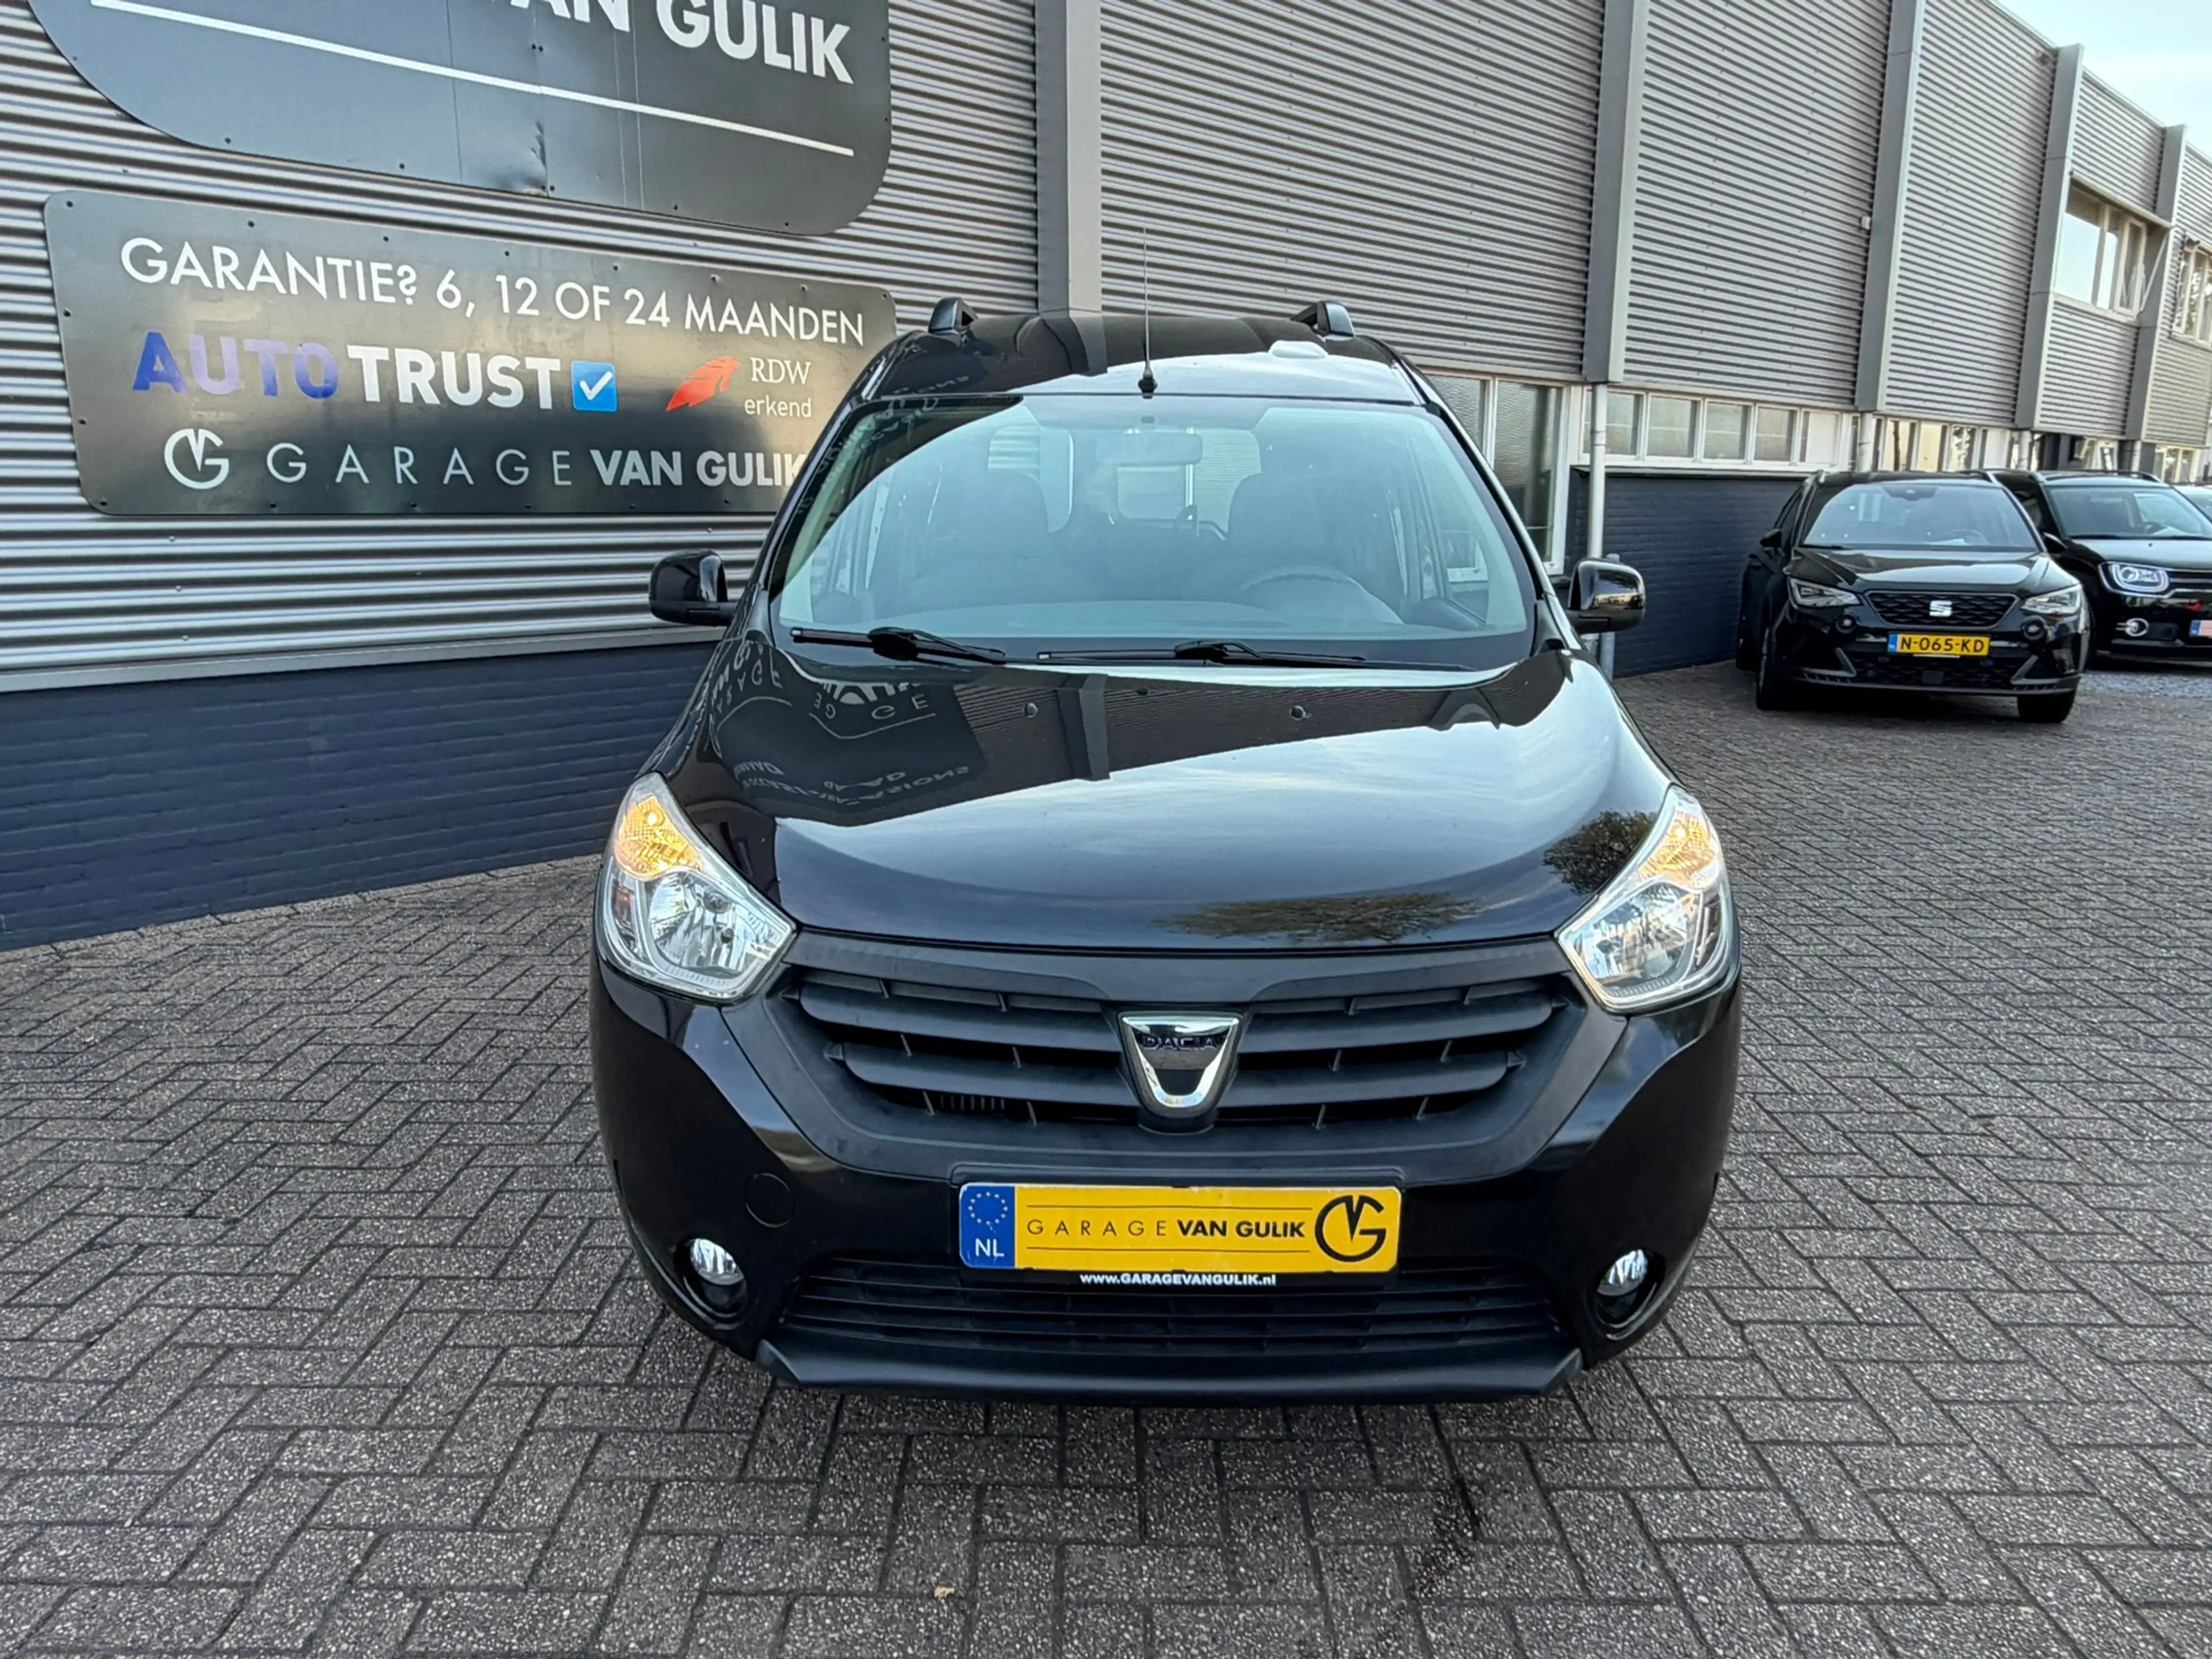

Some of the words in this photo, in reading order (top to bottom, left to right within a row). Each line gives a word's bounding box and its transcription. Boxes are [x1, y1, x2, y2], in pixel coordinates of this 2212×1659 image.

[656, 0, 854, 85] GULIK
[121, 237, 417, 305] GARANTIE?
[437, 269, 475, 317] 6,
[495, 275, 539, 316] 12
[555, 282, 611, 321] OF
[624, 289, 671, 327] 24
[685, 293, 864, 346] MAANDEN
[750, 357, 811, 385] RDW
[744, 396, 812, 418] erkend
[267, 442, 572, 486] GARAGE
[590, 449, 683, 486] VAN
[696, 450, 807, 487] GULIK
[1900, 637, 1984, 653] N-065-KD
[1141, 1035, 1218, 1051] DACIA
[1027, 1219, 1166, 1237] GARAGE
[1177, 1219, 1228, 1237] VAN
[1235, 1220, 1306, 1238] GULIK
[975, 1238, 1005, 1258] NL
[1079, 1273, 1277, 1287] www.GARAGEVANGULIK.nl
